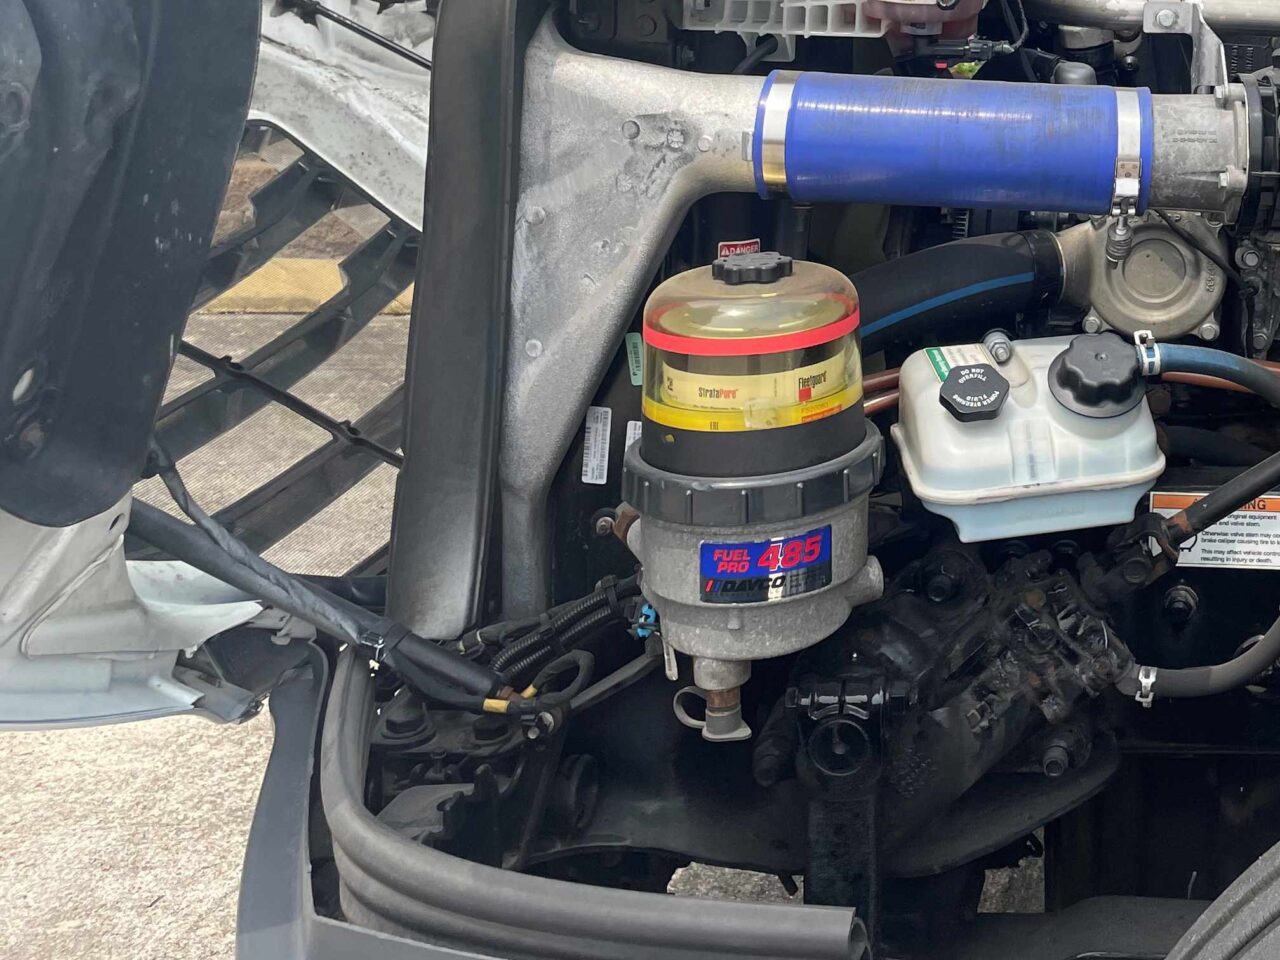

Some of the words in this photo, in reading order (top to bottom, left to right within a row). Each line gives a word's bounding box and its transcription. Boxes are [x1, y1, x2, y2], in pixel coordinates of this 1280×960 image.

[729, 243, 759, 255] DANGER
[958, 373, 988, 384] OVERFILL
[960, 368, 970, 376] DO
[798, 371, 827, 389] Fleetguard
[1248, 514, 1277, 522] equipment
[713, 548, 751, 562] FUEL
[757, 533, 823, 572] 485
[716, 561, 751, 574] PRO
[720, 574, 787, 593] DAVCO
